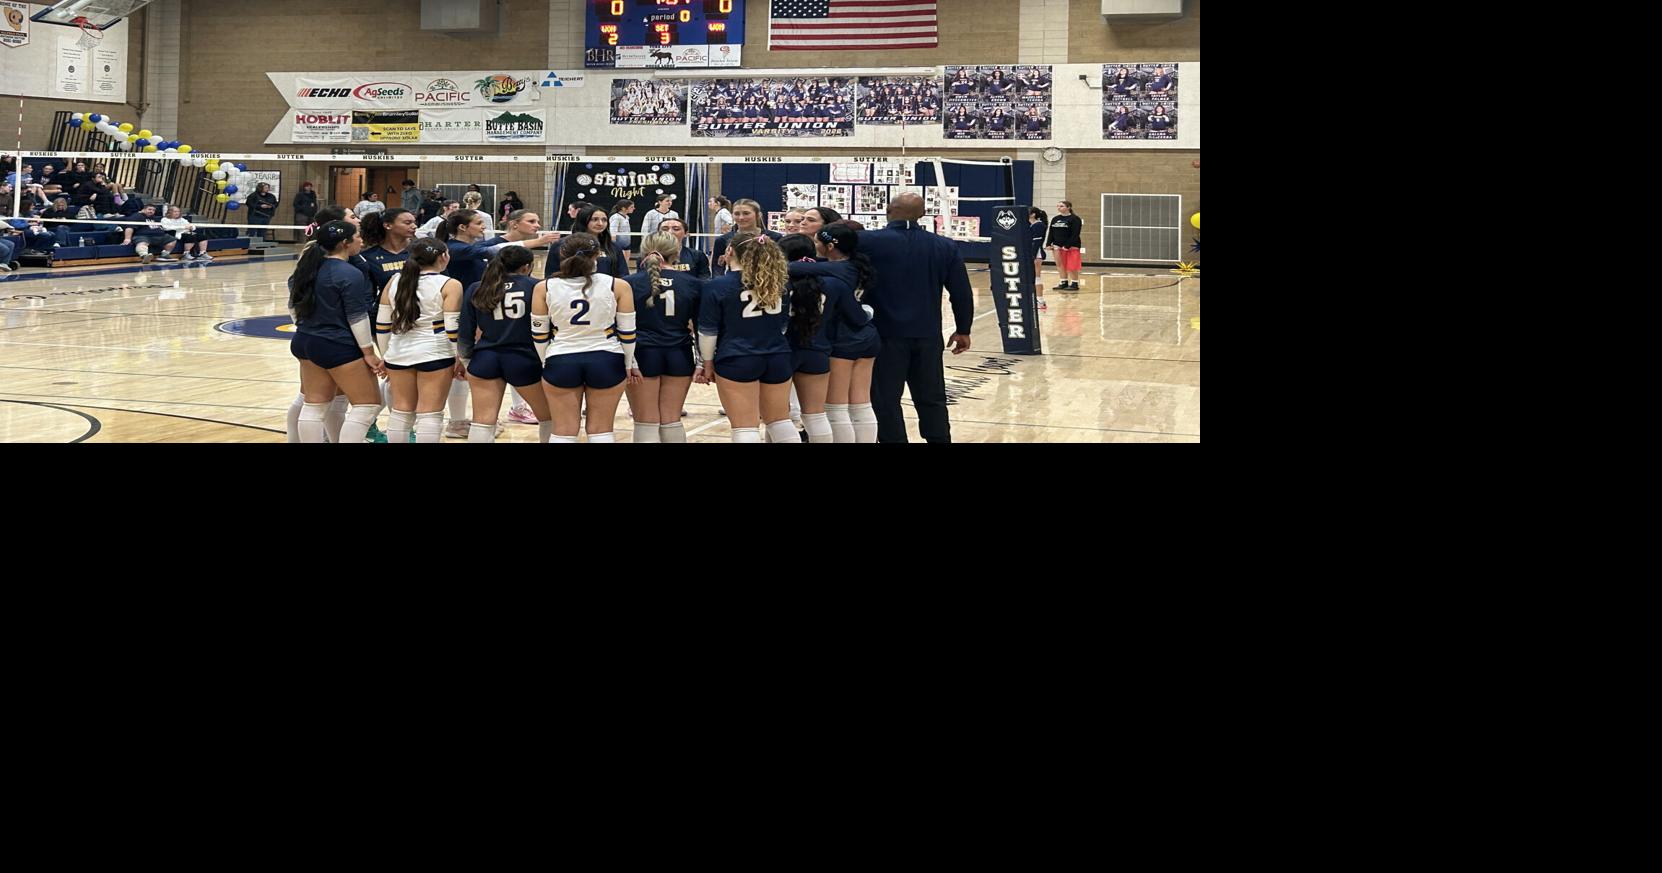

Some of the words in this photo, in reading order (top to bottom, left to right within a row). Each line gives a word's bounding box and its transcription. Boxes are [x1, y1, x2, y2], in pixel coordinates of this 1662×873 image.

[611, 0, 624, 15] 0
[719, 0, 732, 13] 0
[680, 10, 690, 22] 0
[655, 24, 669, 32] SET
[608, 33, 619, 45] 2
[660, 32, 671, 44] 3
[586, 48, 614, 62] BHR
[309, 88, 351, 97] ECHO
[364, 88, 404, 97] AgSeeds
[415, 92, 470, 102] PACIFIC
[296, 115, 350, 124] HOBLIT
[486, 120, 515, 130] BUTTE
[518, 121, 543, 130] BASIN
[594, 173, 659, 186] SENIOR
[610, 187, 645, 199] Night
[1002, 246, 1025, 338] SUTTER
[660, 290, 674, 316] 1
[570, 299, 590, 325] 2
